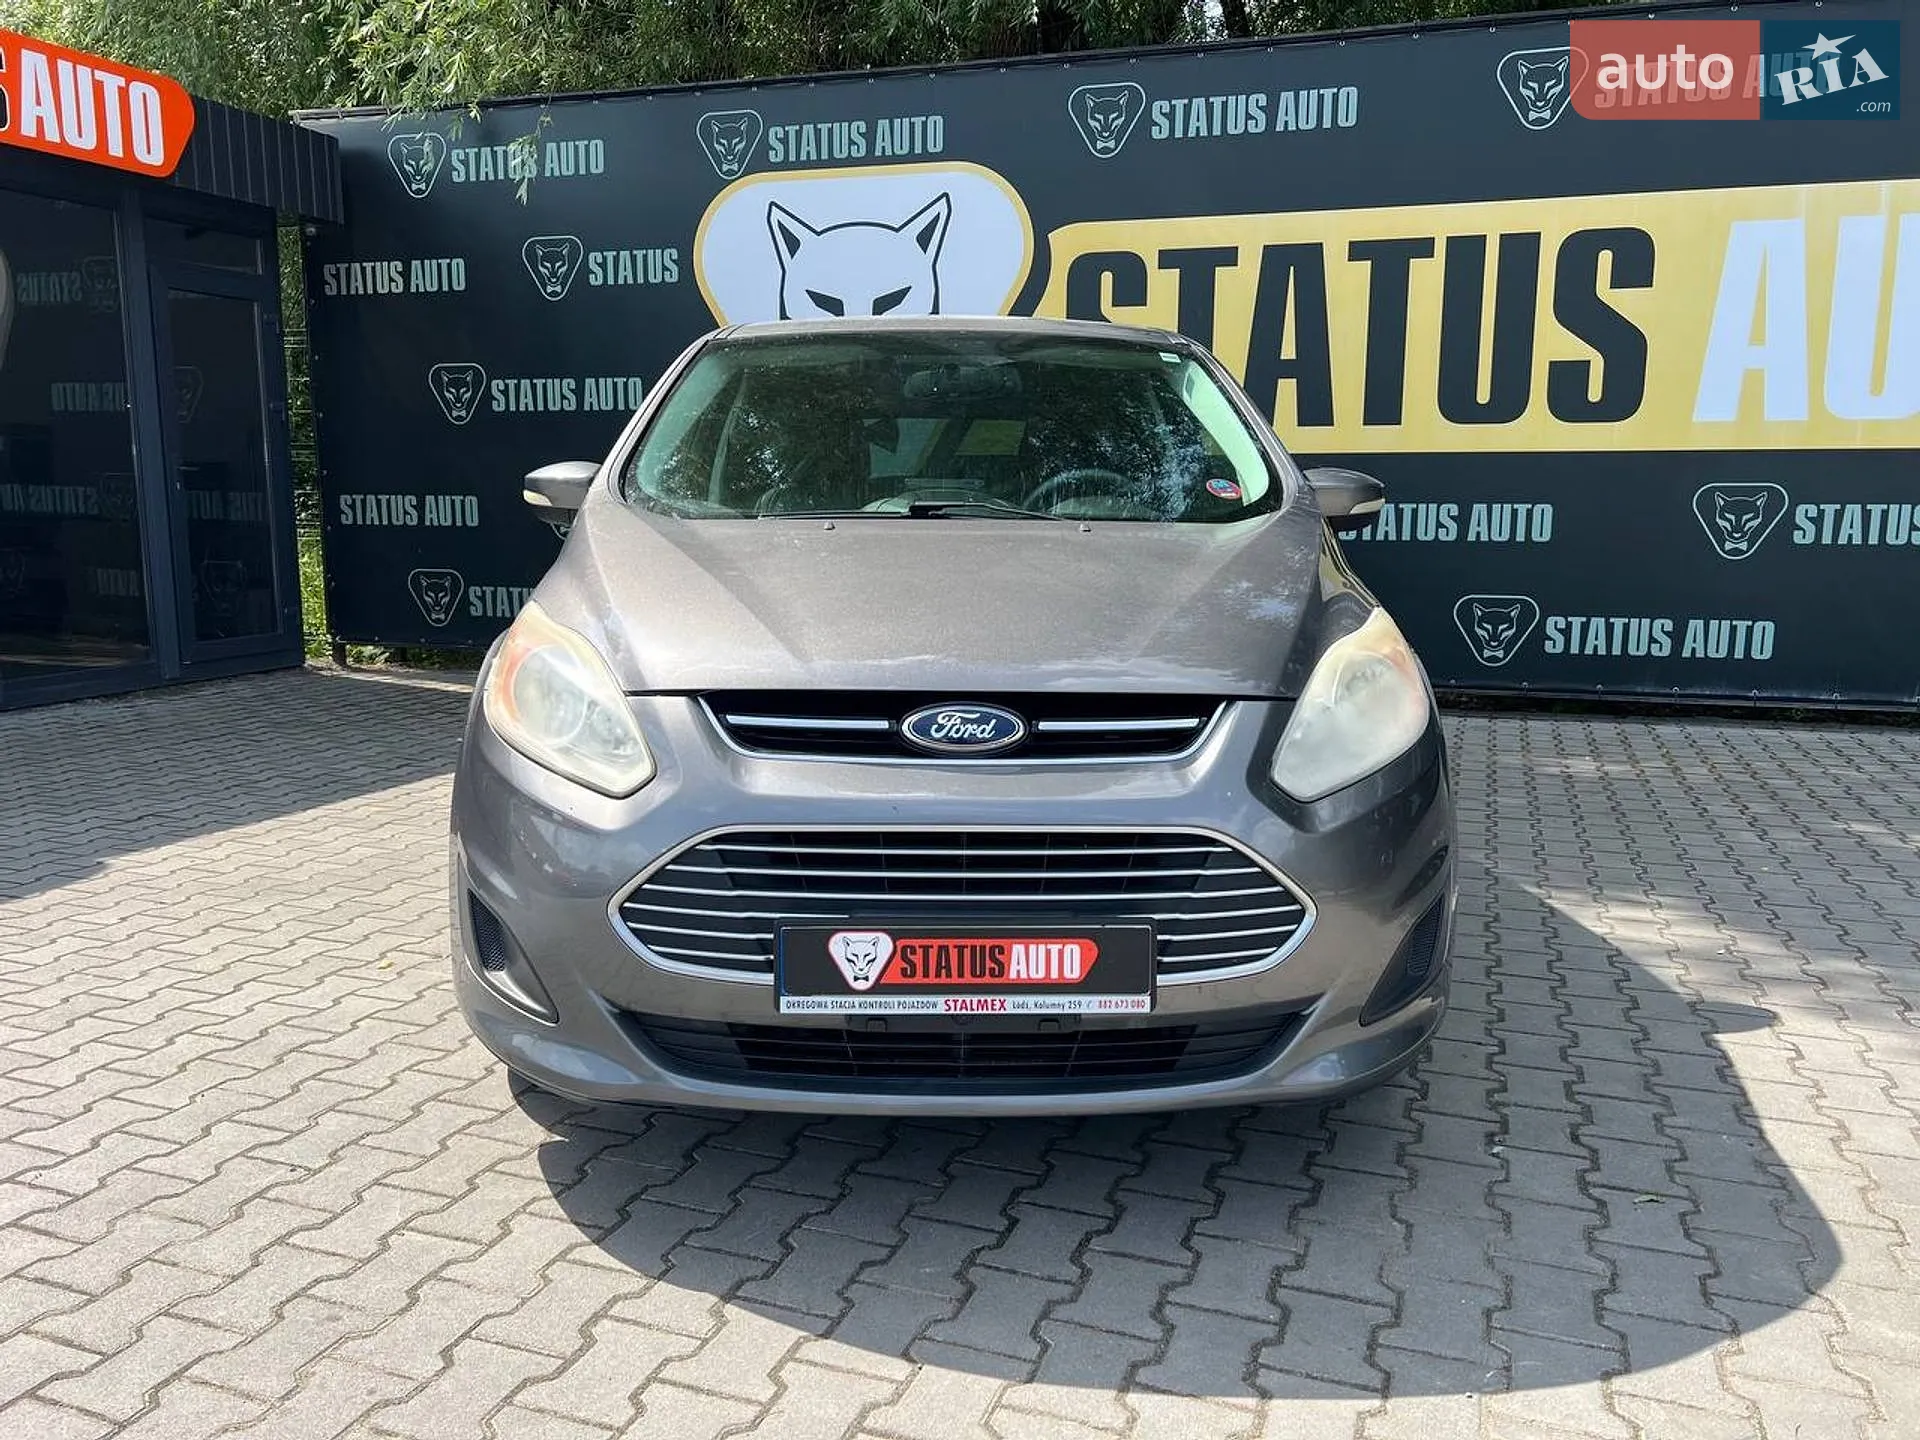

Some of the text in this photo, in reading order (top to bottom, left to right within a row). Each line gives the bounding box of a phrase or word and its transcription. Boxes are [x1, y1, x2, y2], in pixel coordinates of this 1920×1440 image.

[21, 48, 165, 167] AUTO
[1152, 87, 1359, 140] STATUS AUTO
[544, 139, 605, 177] AUTO
[769, 116, 945, 163] STATUS AUTO
[323, 258, 466, 296] STATUS AUTO
[588, 249, 679, 286] STATUS
[490, 377, 643, 412] STATUS AUTO
[339, 495, 480, 527] STATUS AUTO
[1467, 503, 1553, 542] AUTO
[1544, 616, 1776, 661] STATUS AUTO
[930, 711, 998, 739] Ford
[900, 944, 1082, 980] STATUS AUTO
[944, 998, 1007, 1013] STALMEX
